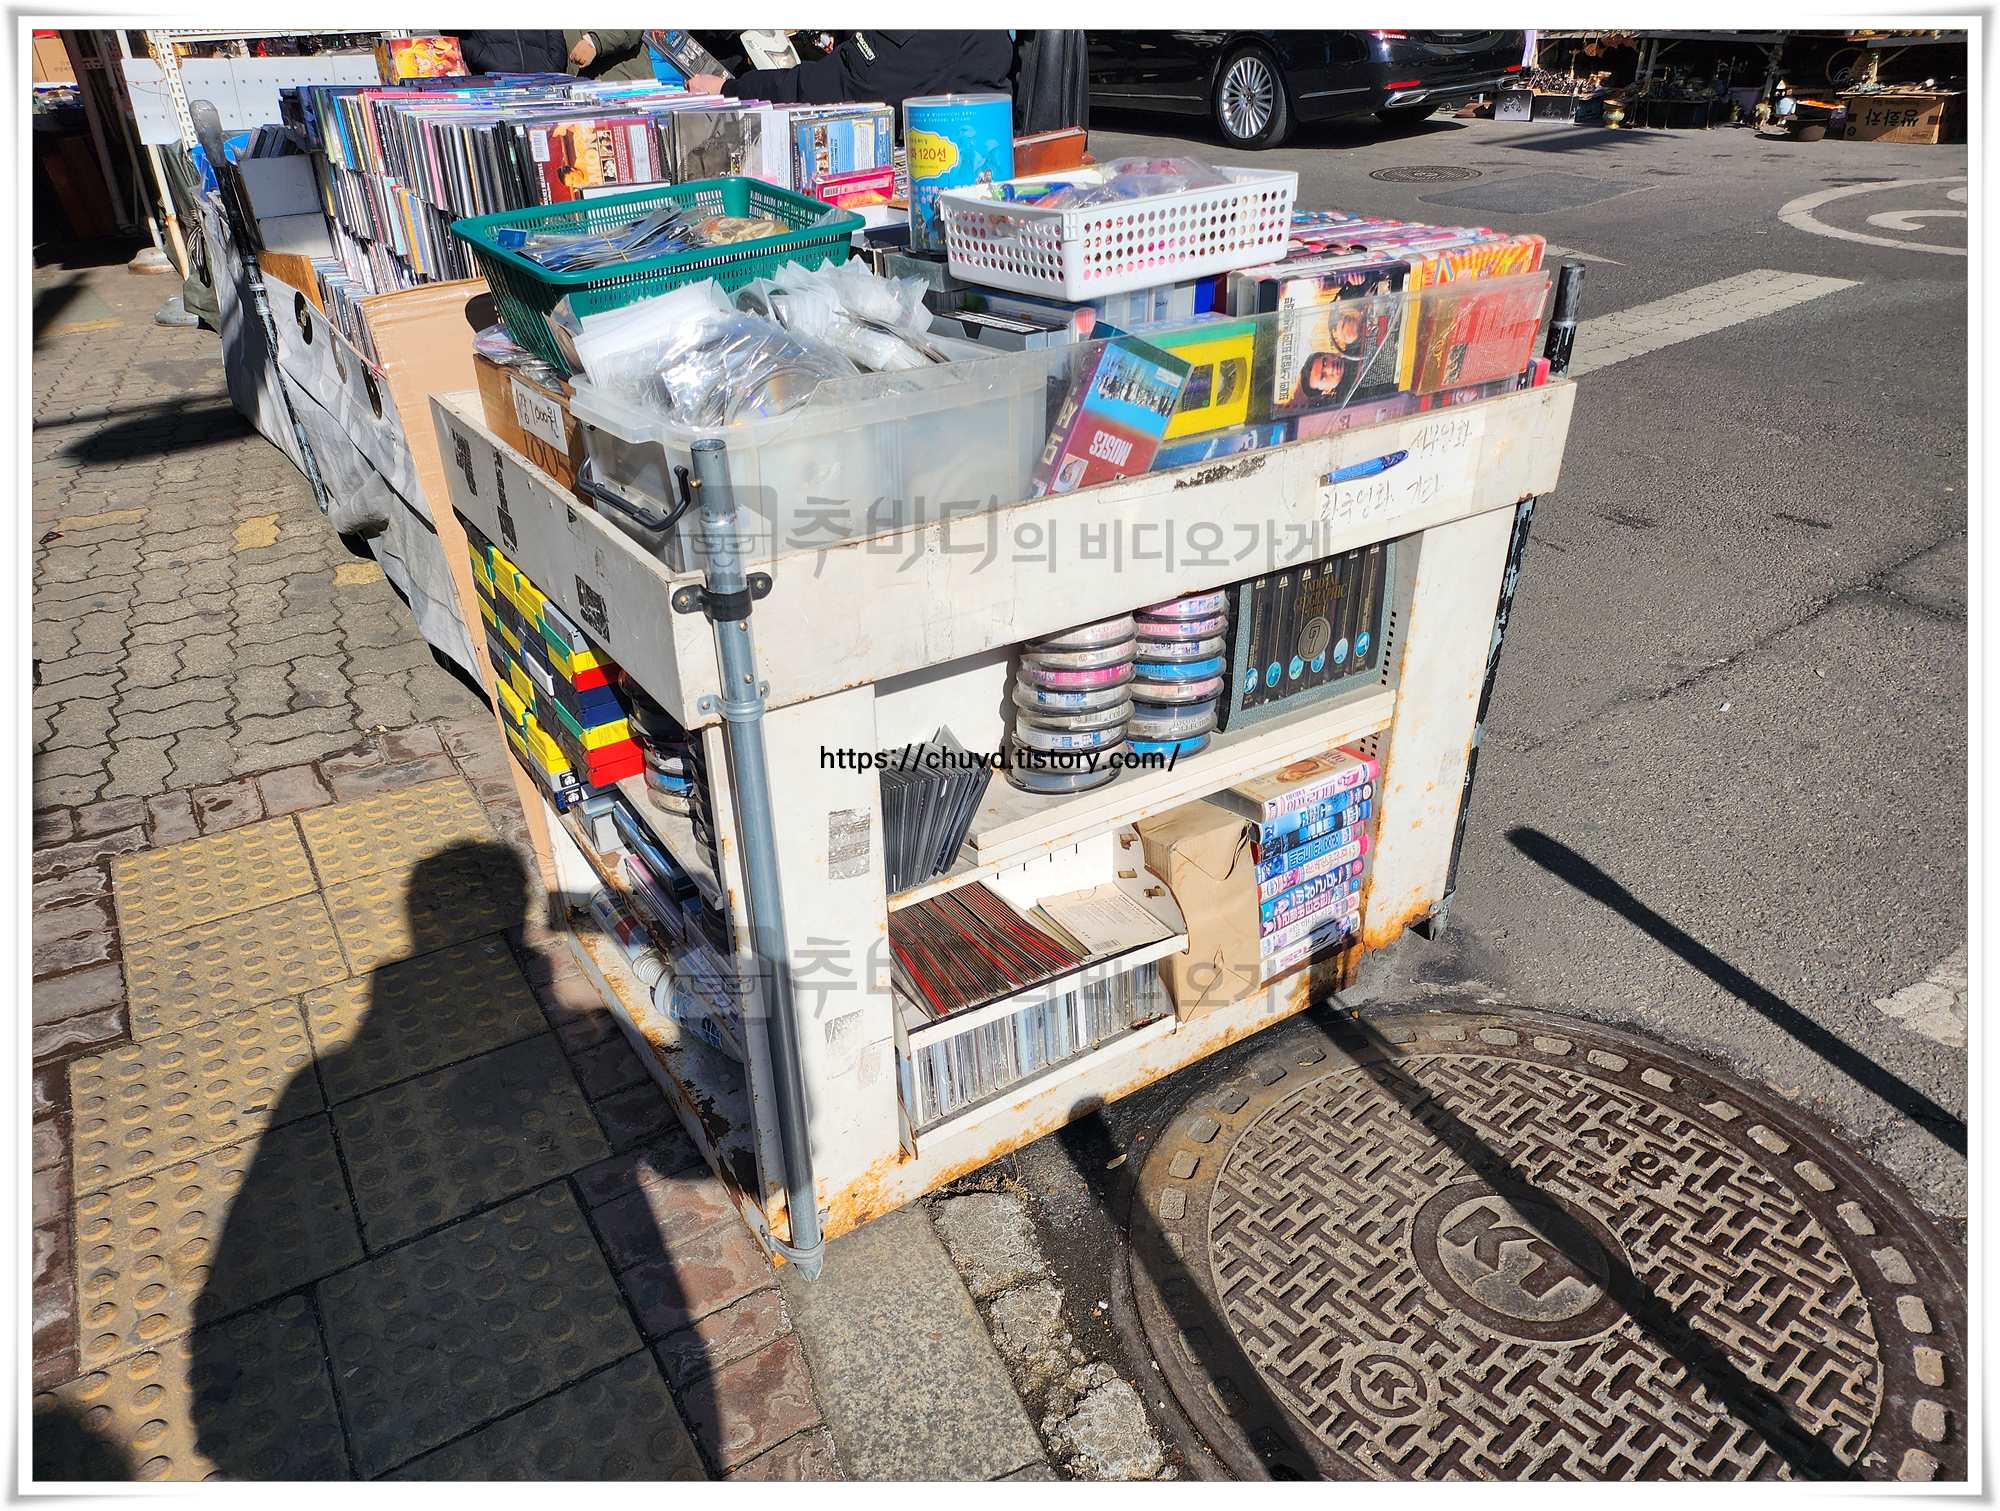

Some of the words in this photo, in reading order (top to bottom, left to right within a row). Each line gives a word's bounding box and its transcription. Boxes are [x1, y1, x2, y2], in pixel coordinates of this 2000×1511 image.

[1865, 108, 1919, 128] 쌍화차
[919, 146, 947, 163] 120선
[1443, 1204, 1597, 1301] KT
